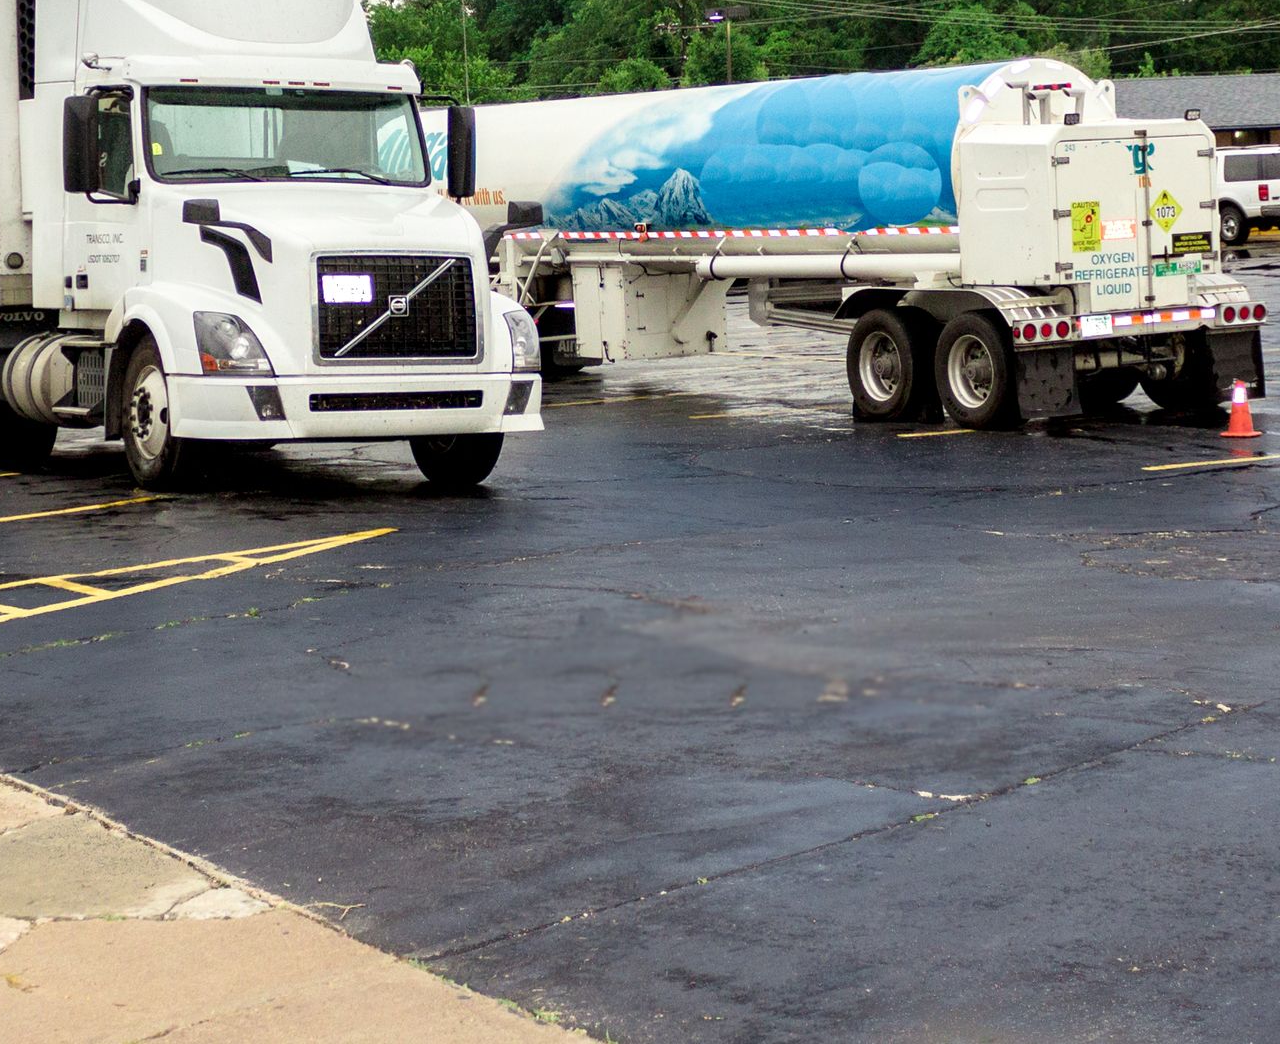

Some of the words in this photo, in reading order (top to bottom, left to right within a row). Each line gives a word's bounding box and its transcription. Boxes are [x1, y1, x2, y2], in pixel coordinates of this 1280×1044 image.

[474, 188, 491, 205] with
[1072, 201, 1100, 209] CAUTION
[1157, 206, 1176, 218] 1073
[1091, 253, 1135, 265] OXYGEN
[1075, 266, 1155, 281] REFRIGERATED
[1097, 283, 1132, 295] LIQUID
